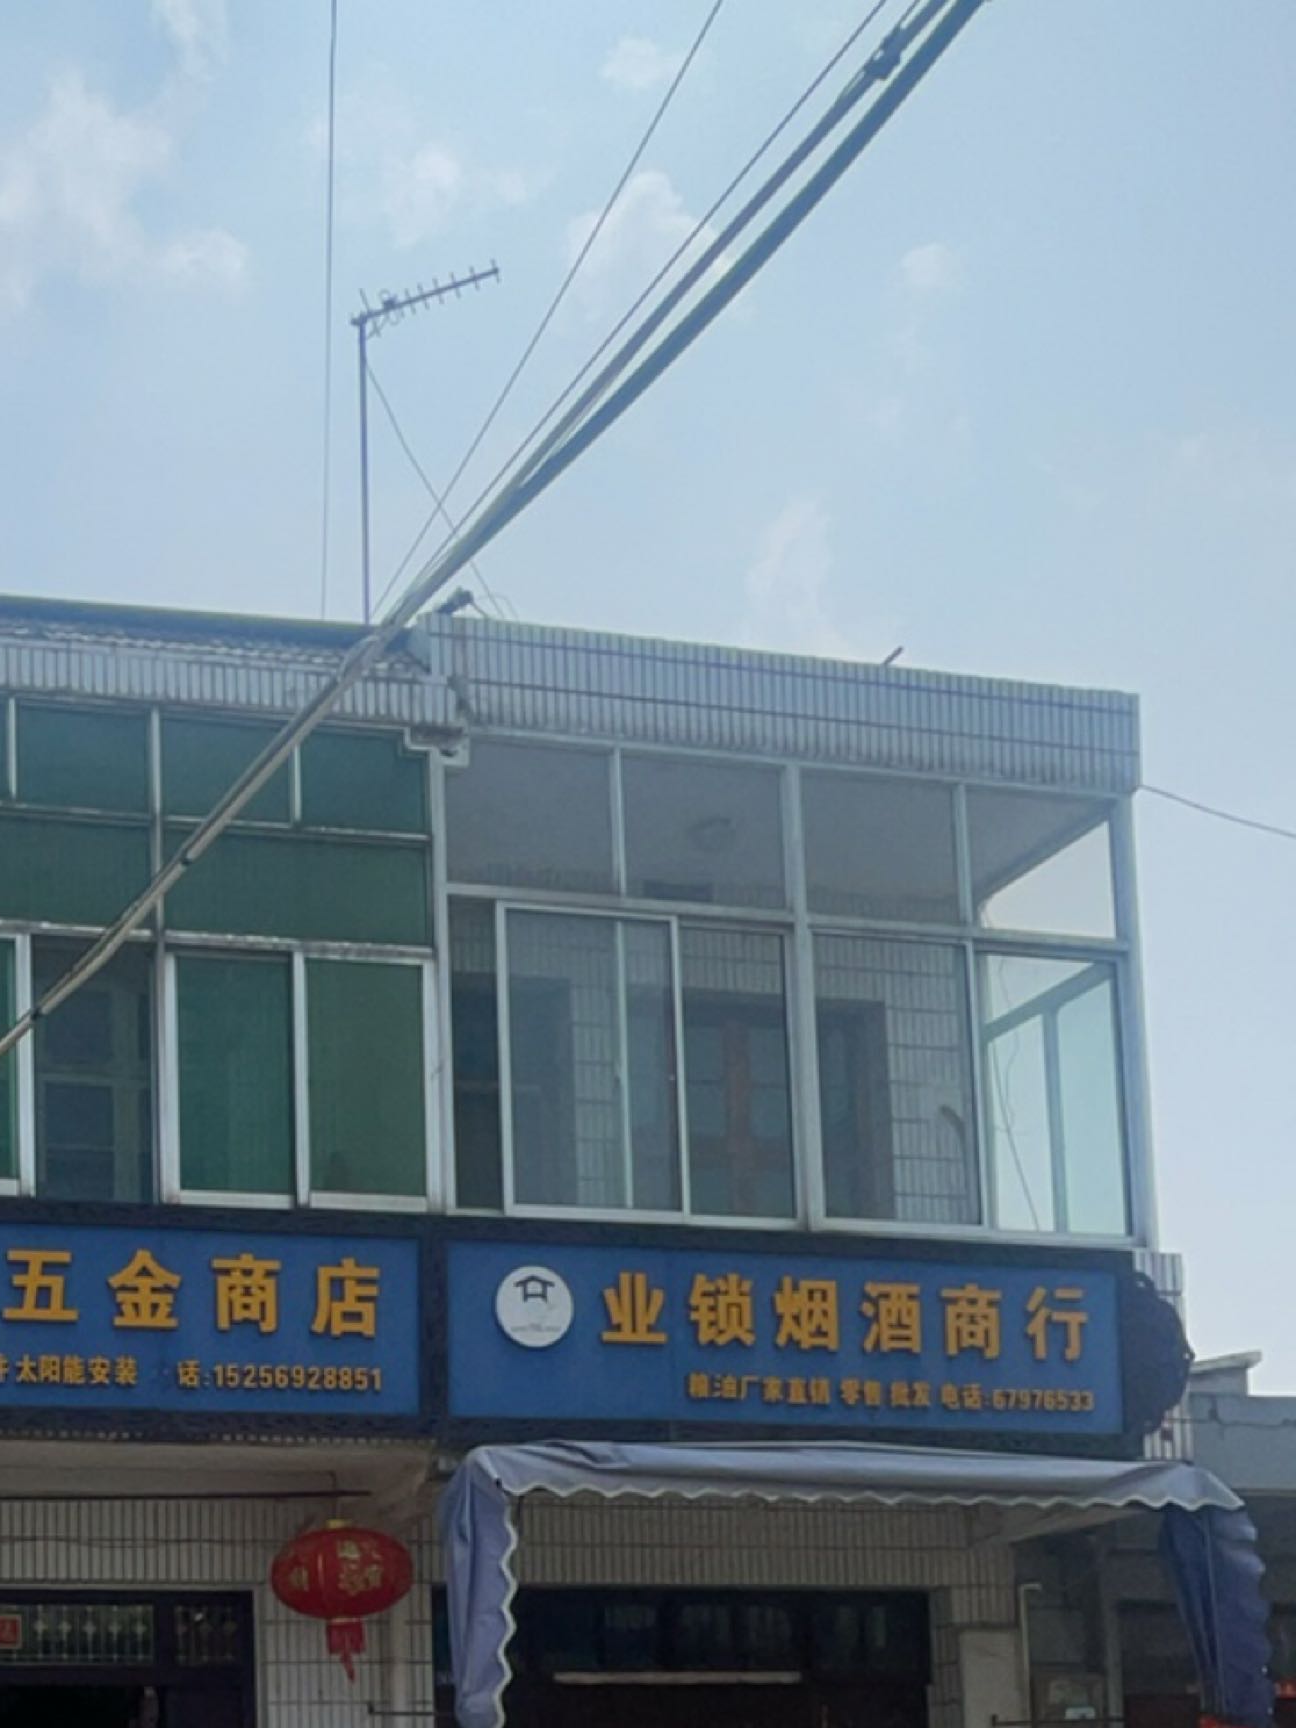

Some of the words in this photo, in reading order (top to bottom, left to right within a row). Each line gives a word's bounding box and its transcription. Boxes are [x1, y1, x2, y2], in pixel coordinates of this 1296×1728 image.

[600, 1270, 1088, 1362] 业锁烟酒商行
[15, 1352, 138, 1386] 太阳能安装
